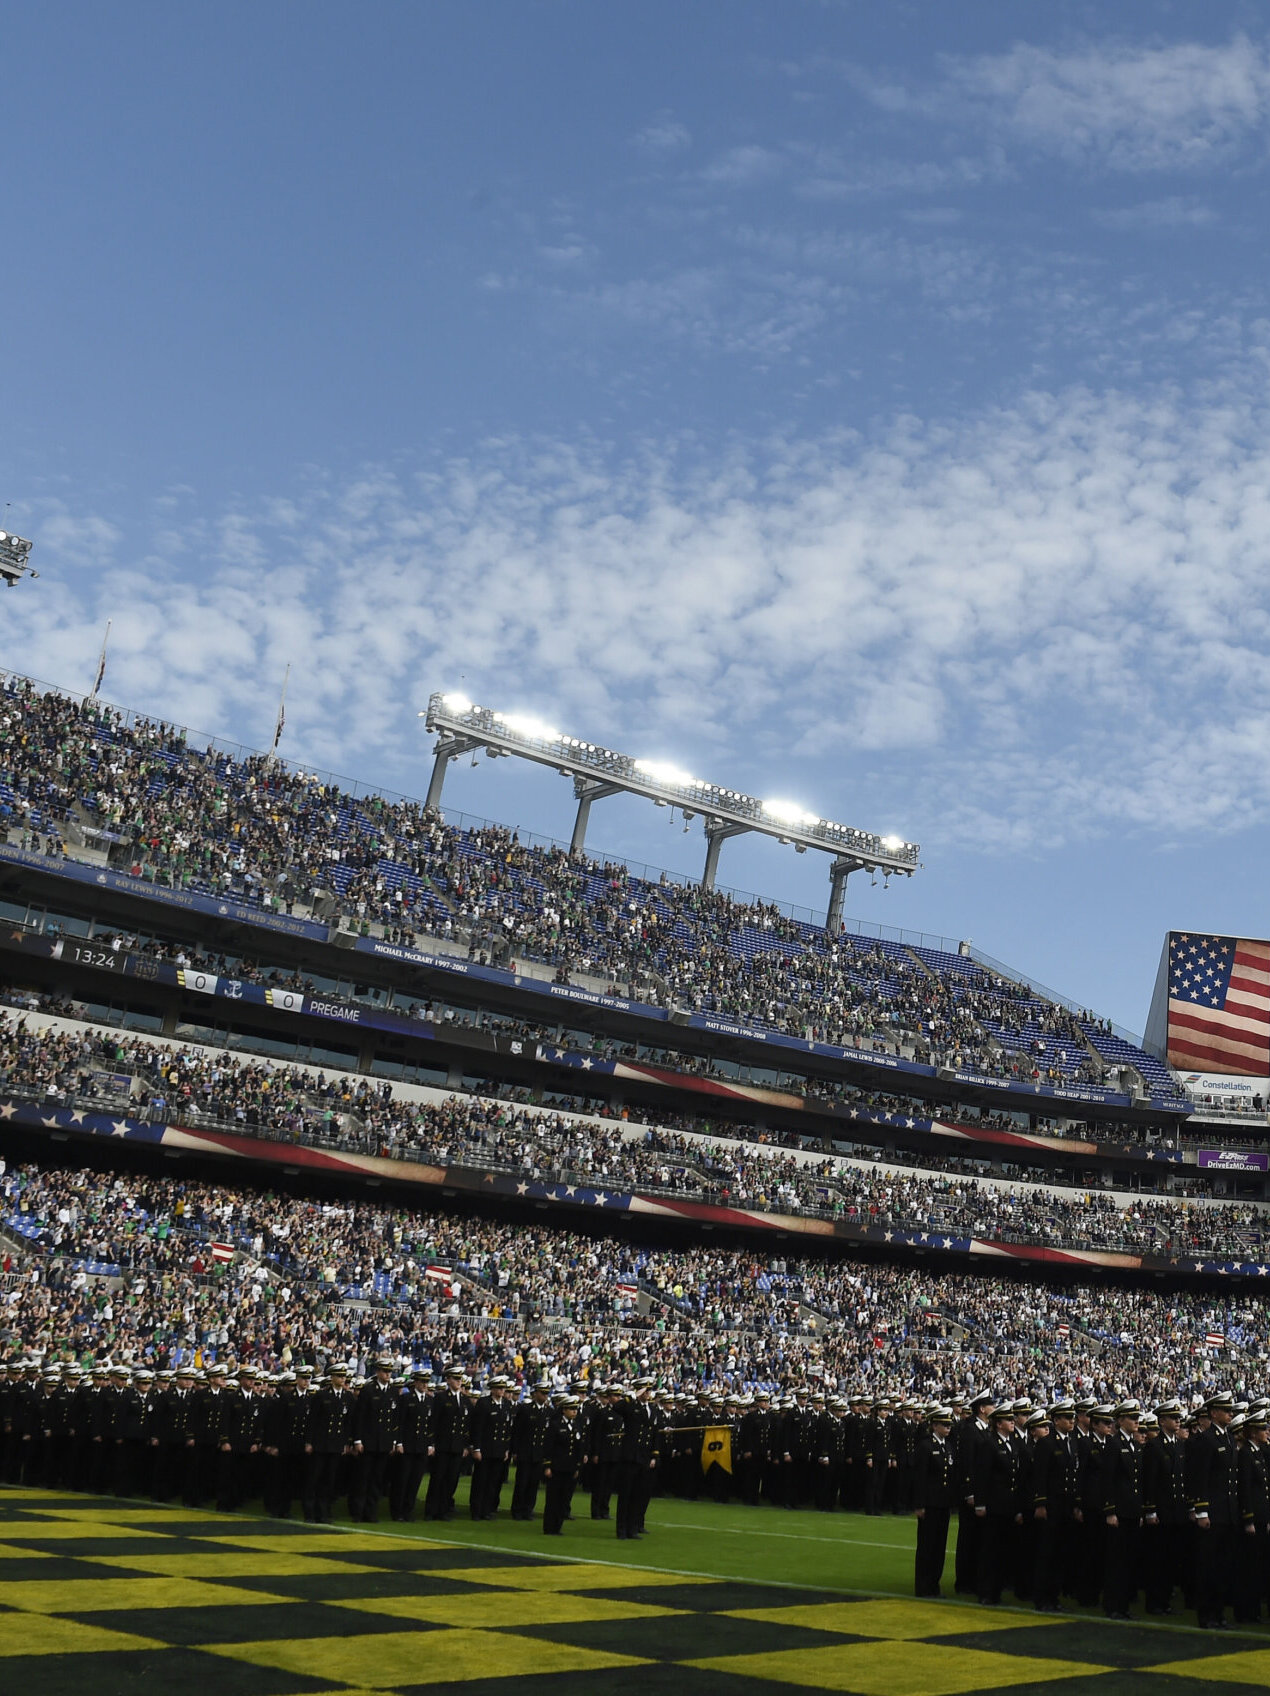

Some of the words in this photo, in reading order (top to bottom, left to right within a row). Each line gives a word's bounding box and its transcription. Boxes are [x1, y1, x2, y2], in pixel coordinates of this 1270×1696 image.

[115, 879, 131, 889] RAY
[131, 882, 153, 895] LEWIS
[236, 909, 247, 919] ED
[248, 912, 267, 924] REED
[74, 947, 116, 969] 13:24
[374, 944, 403, 958] MICHAEL
[434, 959, 468, 973] 1997-2002
[195, 974, 206, 989] 0
[283, 994, 294, 1009] 0
[551, 986, 568, 998] PETER
[569, 989, 600, 1003] BOULWARE
[600, 996, 630, 1010] 1997-2005
[309, 1000, 361, 1022] PREGAME
[705, 1021, 719, 1031] MATT
[720, 1023, 739, 1034] STOVER
[842, 1050, 858, 1060] JAMAL
[858, 1053, 873, 1063] LEWIS
[955, 1073, 968, 1081] BRIAN
[968, 1075, 985, 1085] BILLICK
[1203, 1080, 1252, 1091] Constellation
[1054, 1089, 1067, 1097] TODD
[1067, 1091, 1080, 1099] HEAP
[1207, 1161, 1261, 1171] DriveEzMD.com
